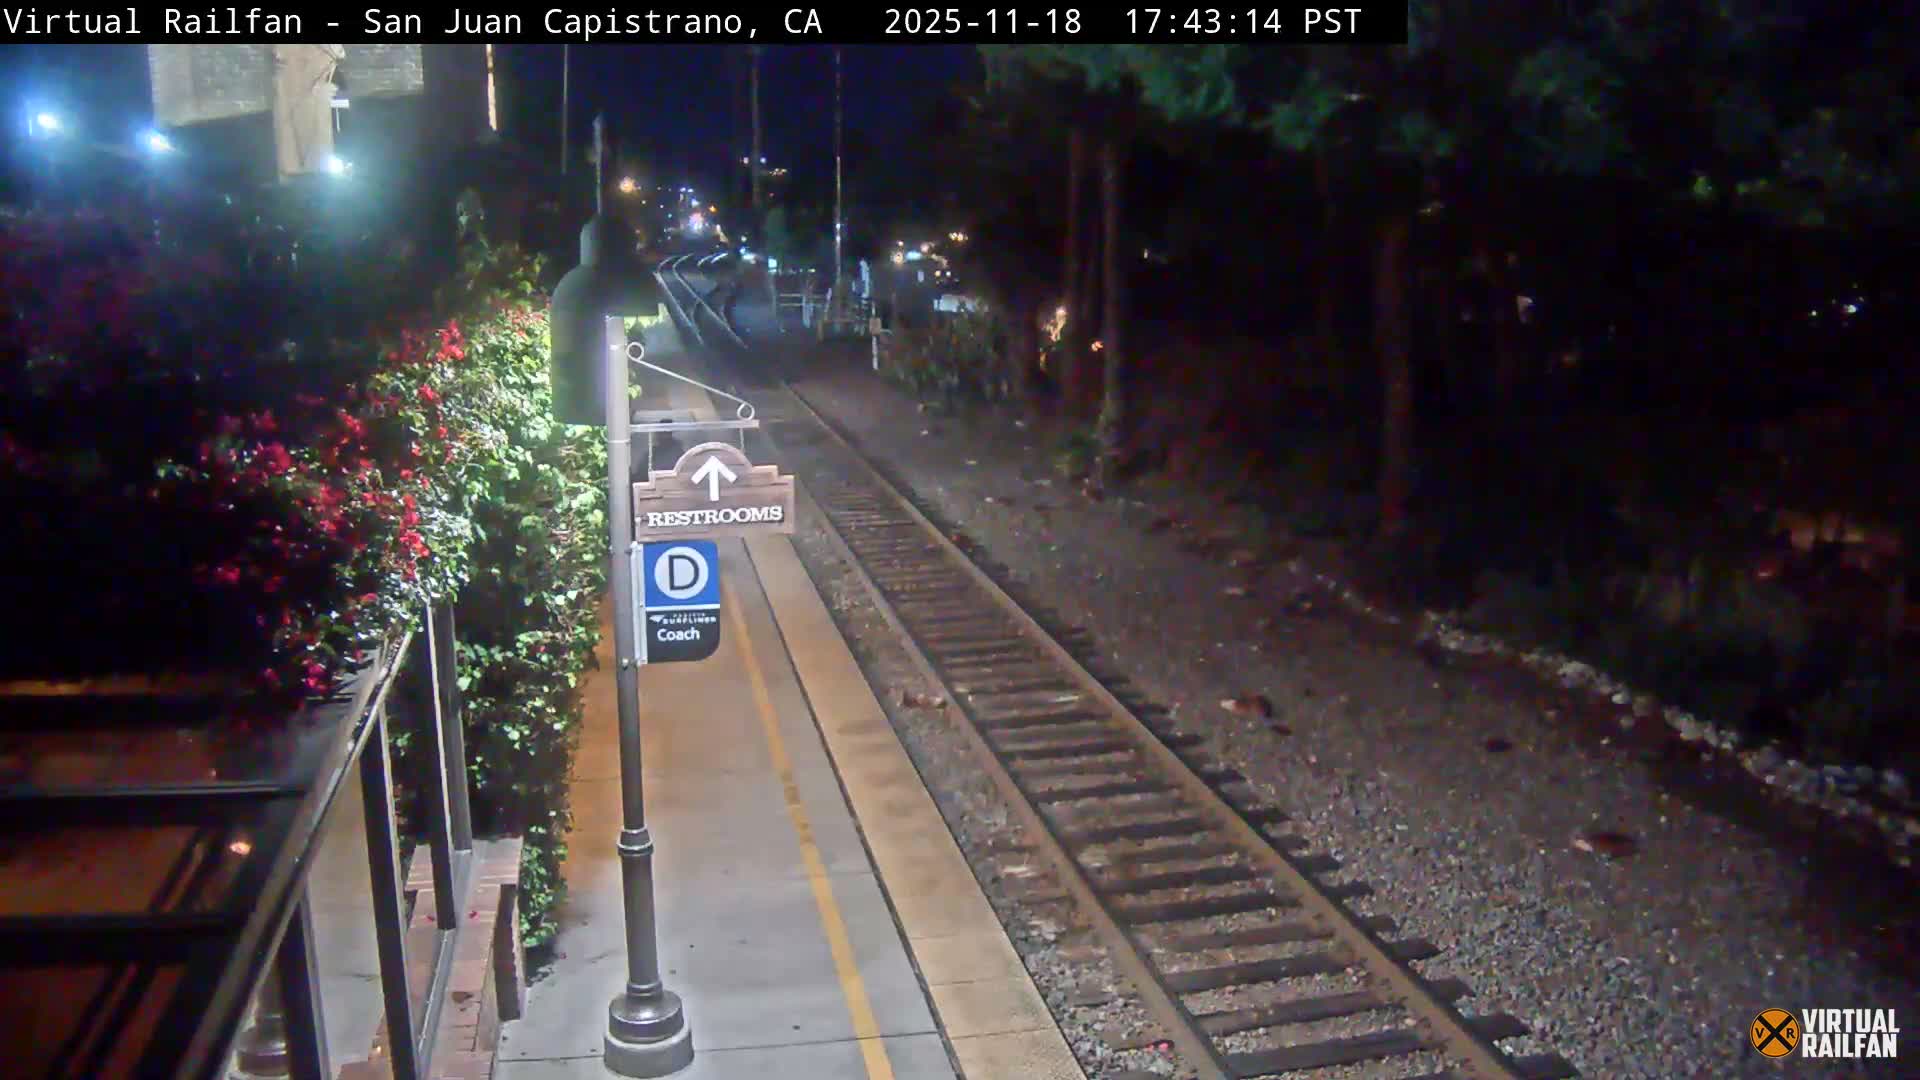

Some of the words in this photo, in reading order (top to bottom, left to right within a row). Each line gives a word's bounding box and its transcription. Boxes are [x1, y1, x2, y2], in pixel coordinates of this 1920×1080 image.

[647, 505, 784, 527] RESTROOMS
[668, 554, 700, 591] D
[656, 626, 701, 641] Coach
